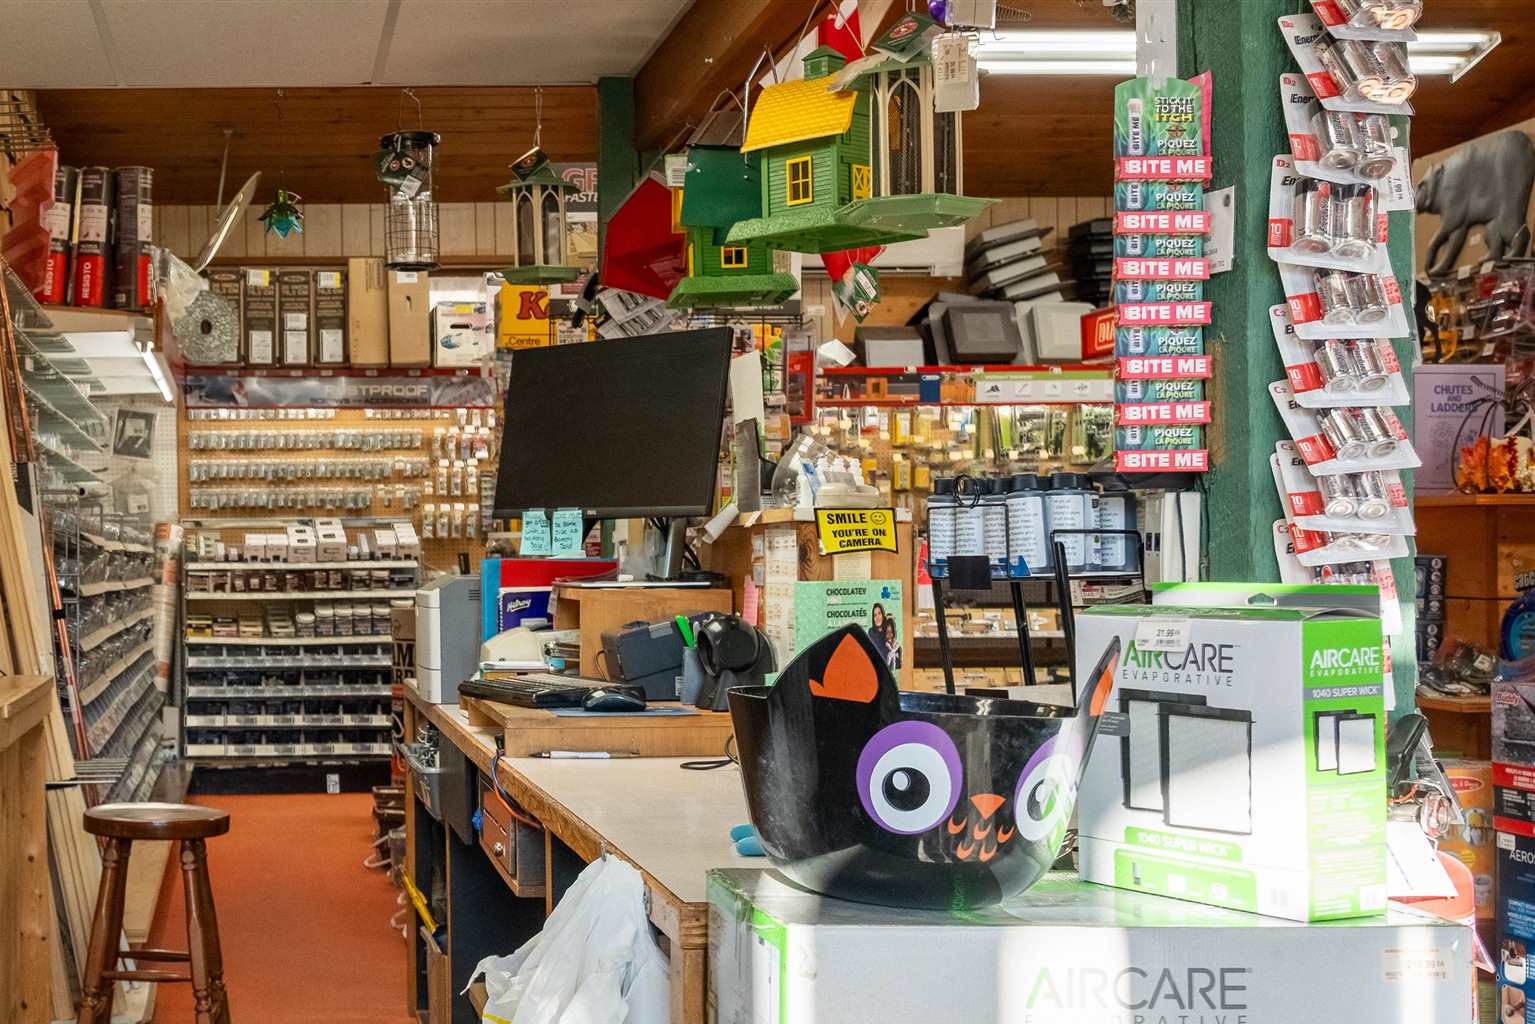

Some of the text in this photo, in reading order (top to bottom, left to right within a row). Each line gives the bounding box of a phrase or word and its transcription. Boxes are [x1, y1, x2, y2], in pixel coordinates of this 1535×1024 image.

[1130, 160, 1205, 174] BITE ME
[1156, 193, 1194, 201] PIQUEZ
[1128, 214, 1204, 229] BITE ME
[1156, 239, 1195, 247] PIQUEZ
[1128, 261, 1204, 275] BITE ME
[81, 261, 92, 299] RESISTO
[1156, 284, 1195, 292] PIQUEZ
[1129, 305, 1205, 319] BITE ME
[508, 337, 541, 346] Centre
[1158, 337, 1196, 345] PIQUEZ
[1131, 359, 1206, 373] BITE ME
[1155, 382, 1194, 390] PIQUEZ
[1434, 385, 1473, 395] CHUTES
[1129, 405, 1204, 420] BITE ME
[1154, 428, 1192, 436] PIQUEZ
[1128, 453, 1203, 467] BITE ME
[826, 513, 868, 525] SMILE
[832, 528, 887, 538] YOU'RE ON
[839, 538, 882, 548] CAMERA
[1122, 640, 1234, 673] AIRCARE
[1310, 646, 1381, 669] AIRCARE
[1310, 665, 1380, 677] EVAPORATIVE
[1122, 671, 1234, 687] EVAPORATIVE
[1312, 685, 1379, 699] 1040 SUPER WICK
[1024, 966, 1249, 1010] AIRCARE
